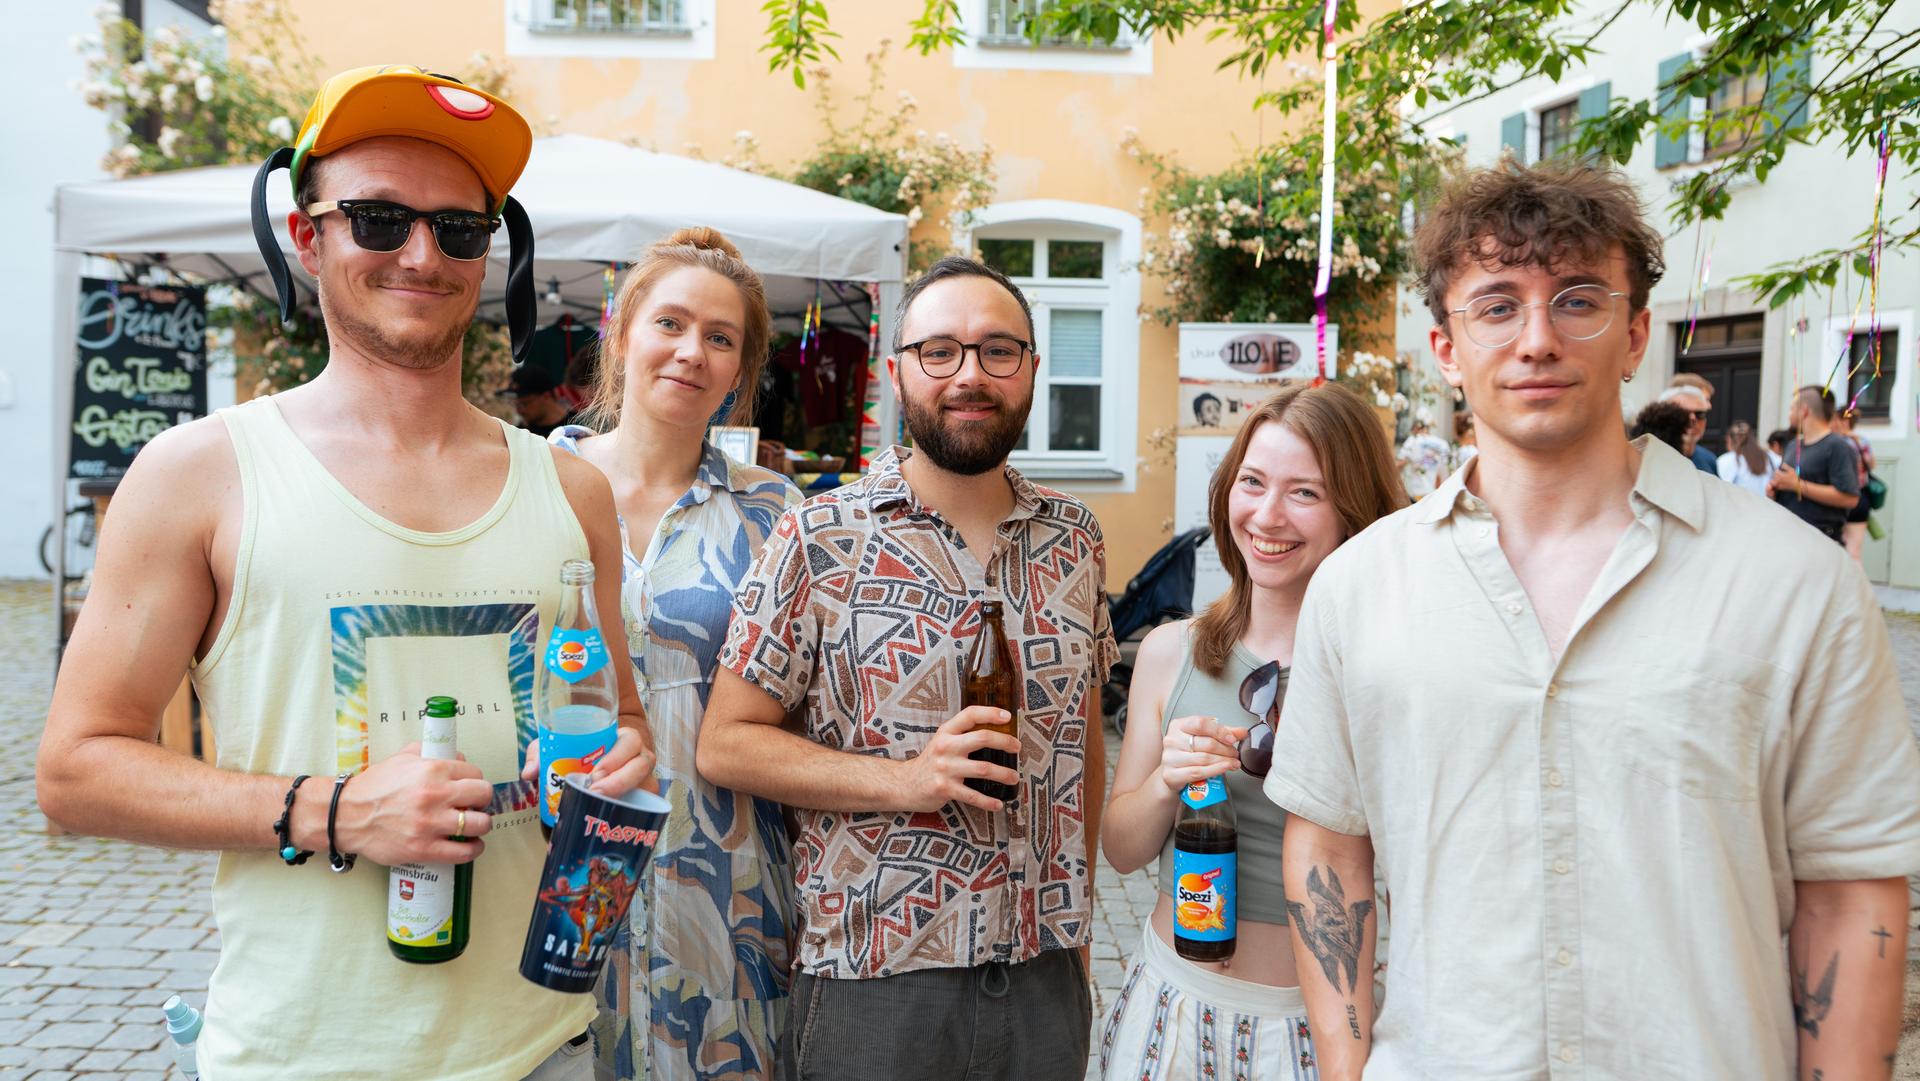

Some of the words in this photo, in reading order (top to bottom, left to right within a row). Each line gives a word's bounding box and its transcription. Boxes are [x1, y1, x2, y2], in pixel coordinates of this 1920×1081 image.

[79, 290, 206, 351] Drinks
[374, 589, 443, 598] NINETEEN
[455, 590, 498, 598] SIXTY
[510, 588, 541, 597] NINE
[380, 710, 426, 723] RIP
[457, 702, 500, 716] URL
[1179, 886, 1211, 903] Spezi
[1347, 1005, 1361, 1039] DEUS
